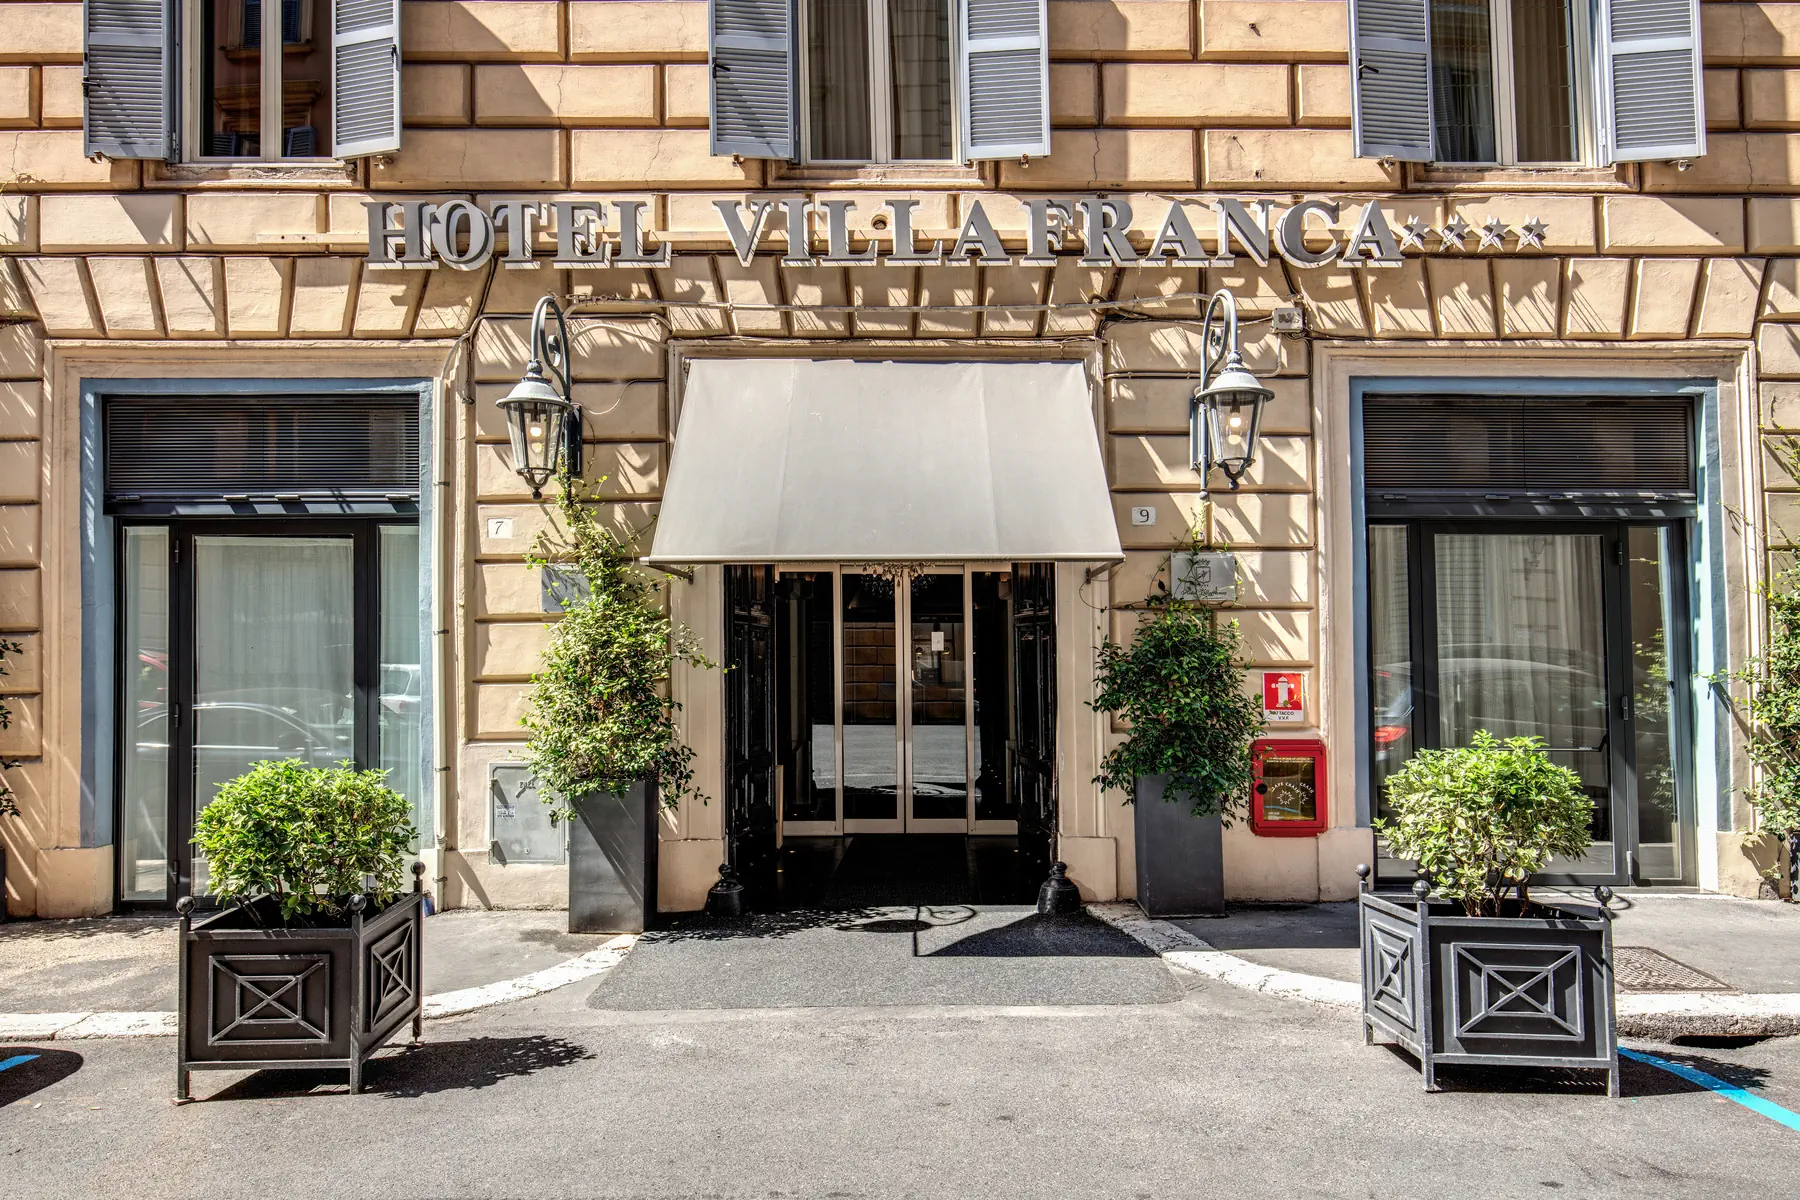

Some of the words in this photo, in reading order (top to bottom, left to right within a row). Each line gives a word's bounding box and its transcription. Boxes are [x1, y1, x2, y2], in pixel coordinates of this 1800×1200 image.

[365, 199, 671, 269] HOTEL
[712, 198, 1405, 268] VILLAFRANCA
[1140, 509, 1149, 522] 9
[495, 521, 504, 534] 7
